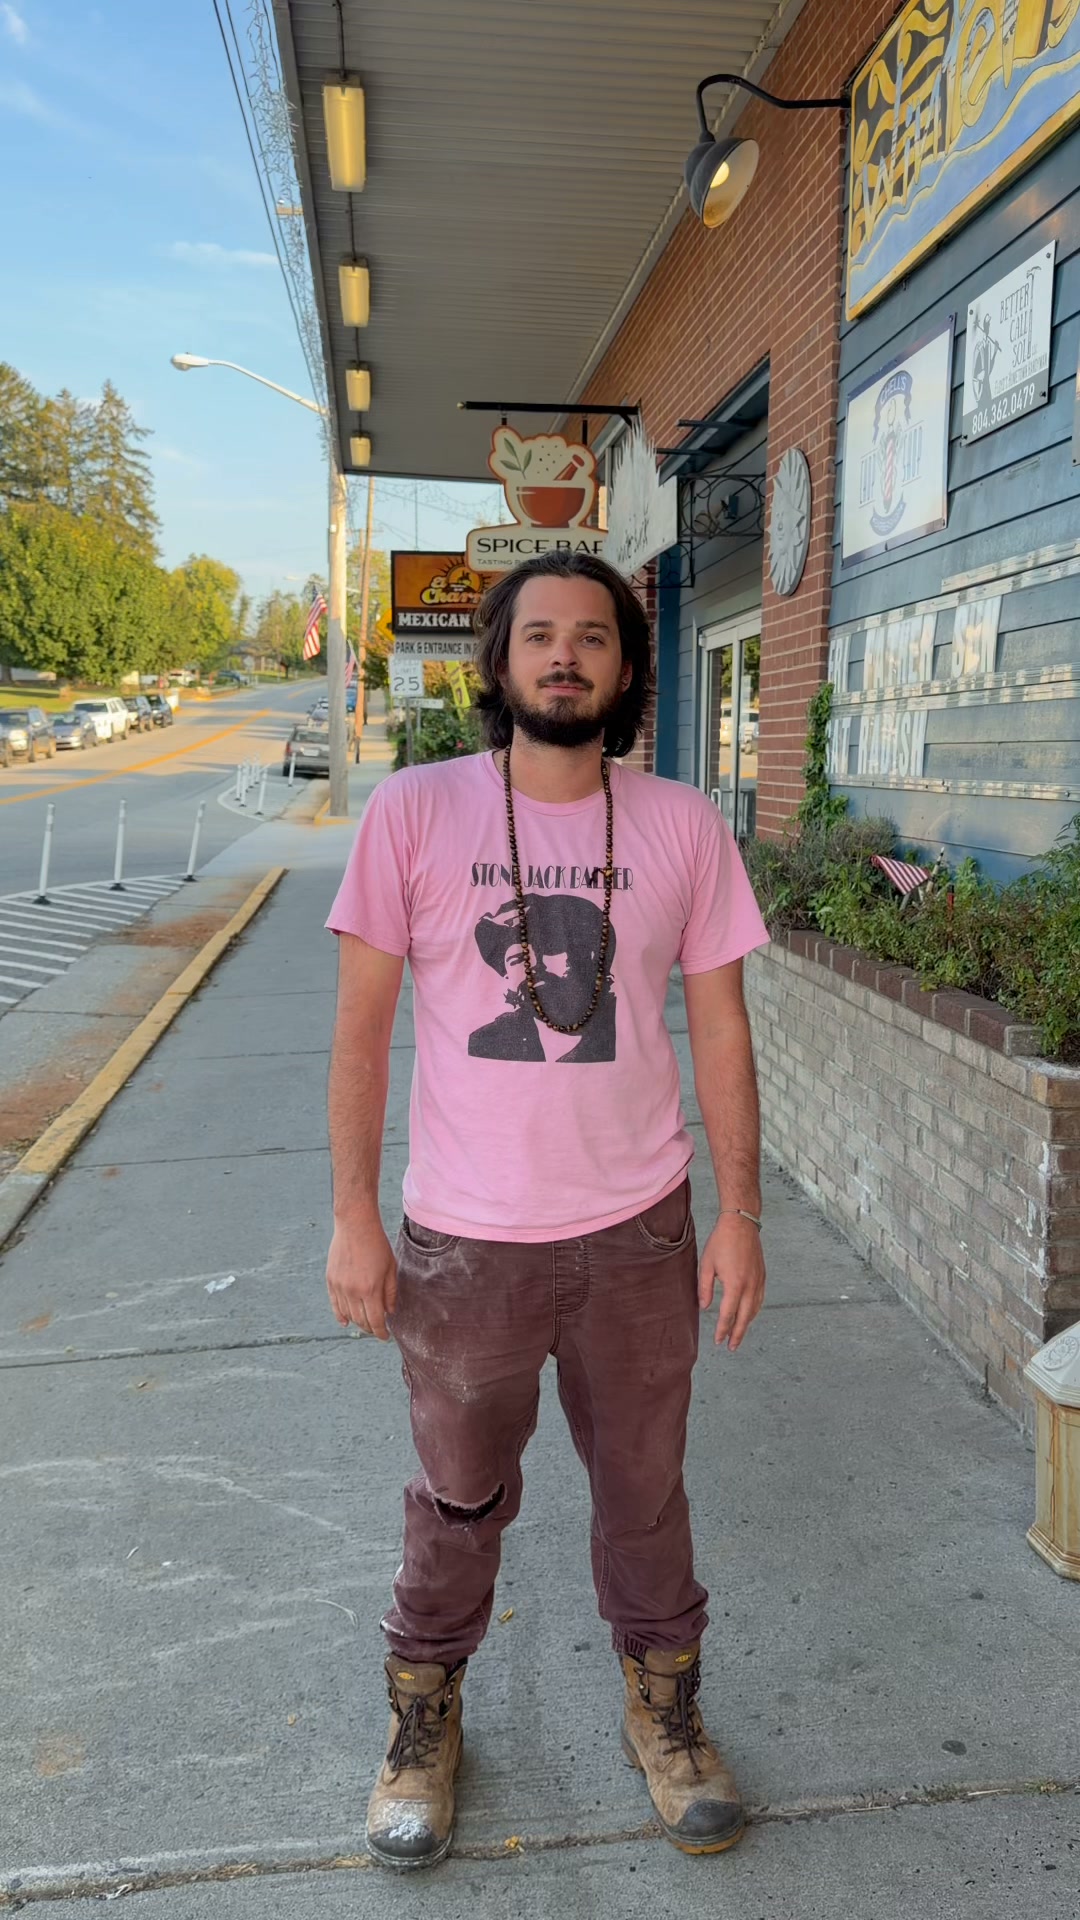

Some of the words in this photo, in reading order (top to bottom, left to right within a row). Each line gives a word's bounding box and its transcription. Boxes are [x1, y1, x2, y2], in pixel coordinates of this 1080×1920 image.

[1000, 283, 1029, 324] BETTER
[1010, 311, 1027, 342] CALL
[972, 383, 1035, 435] 804.362.0479
[477, 538, 549, 554] SPICE
[421, 588, 482, 604] Charr
[397, 612, 471, 627] MEXICAN
[396, 642, 416, 655] PARK
[424, 642, 462, 655] ENTRANCE
[463, 643, 471, 655] IN
[393, 677, 420, 692] 25
[524, 865, 567, 888] JACK
